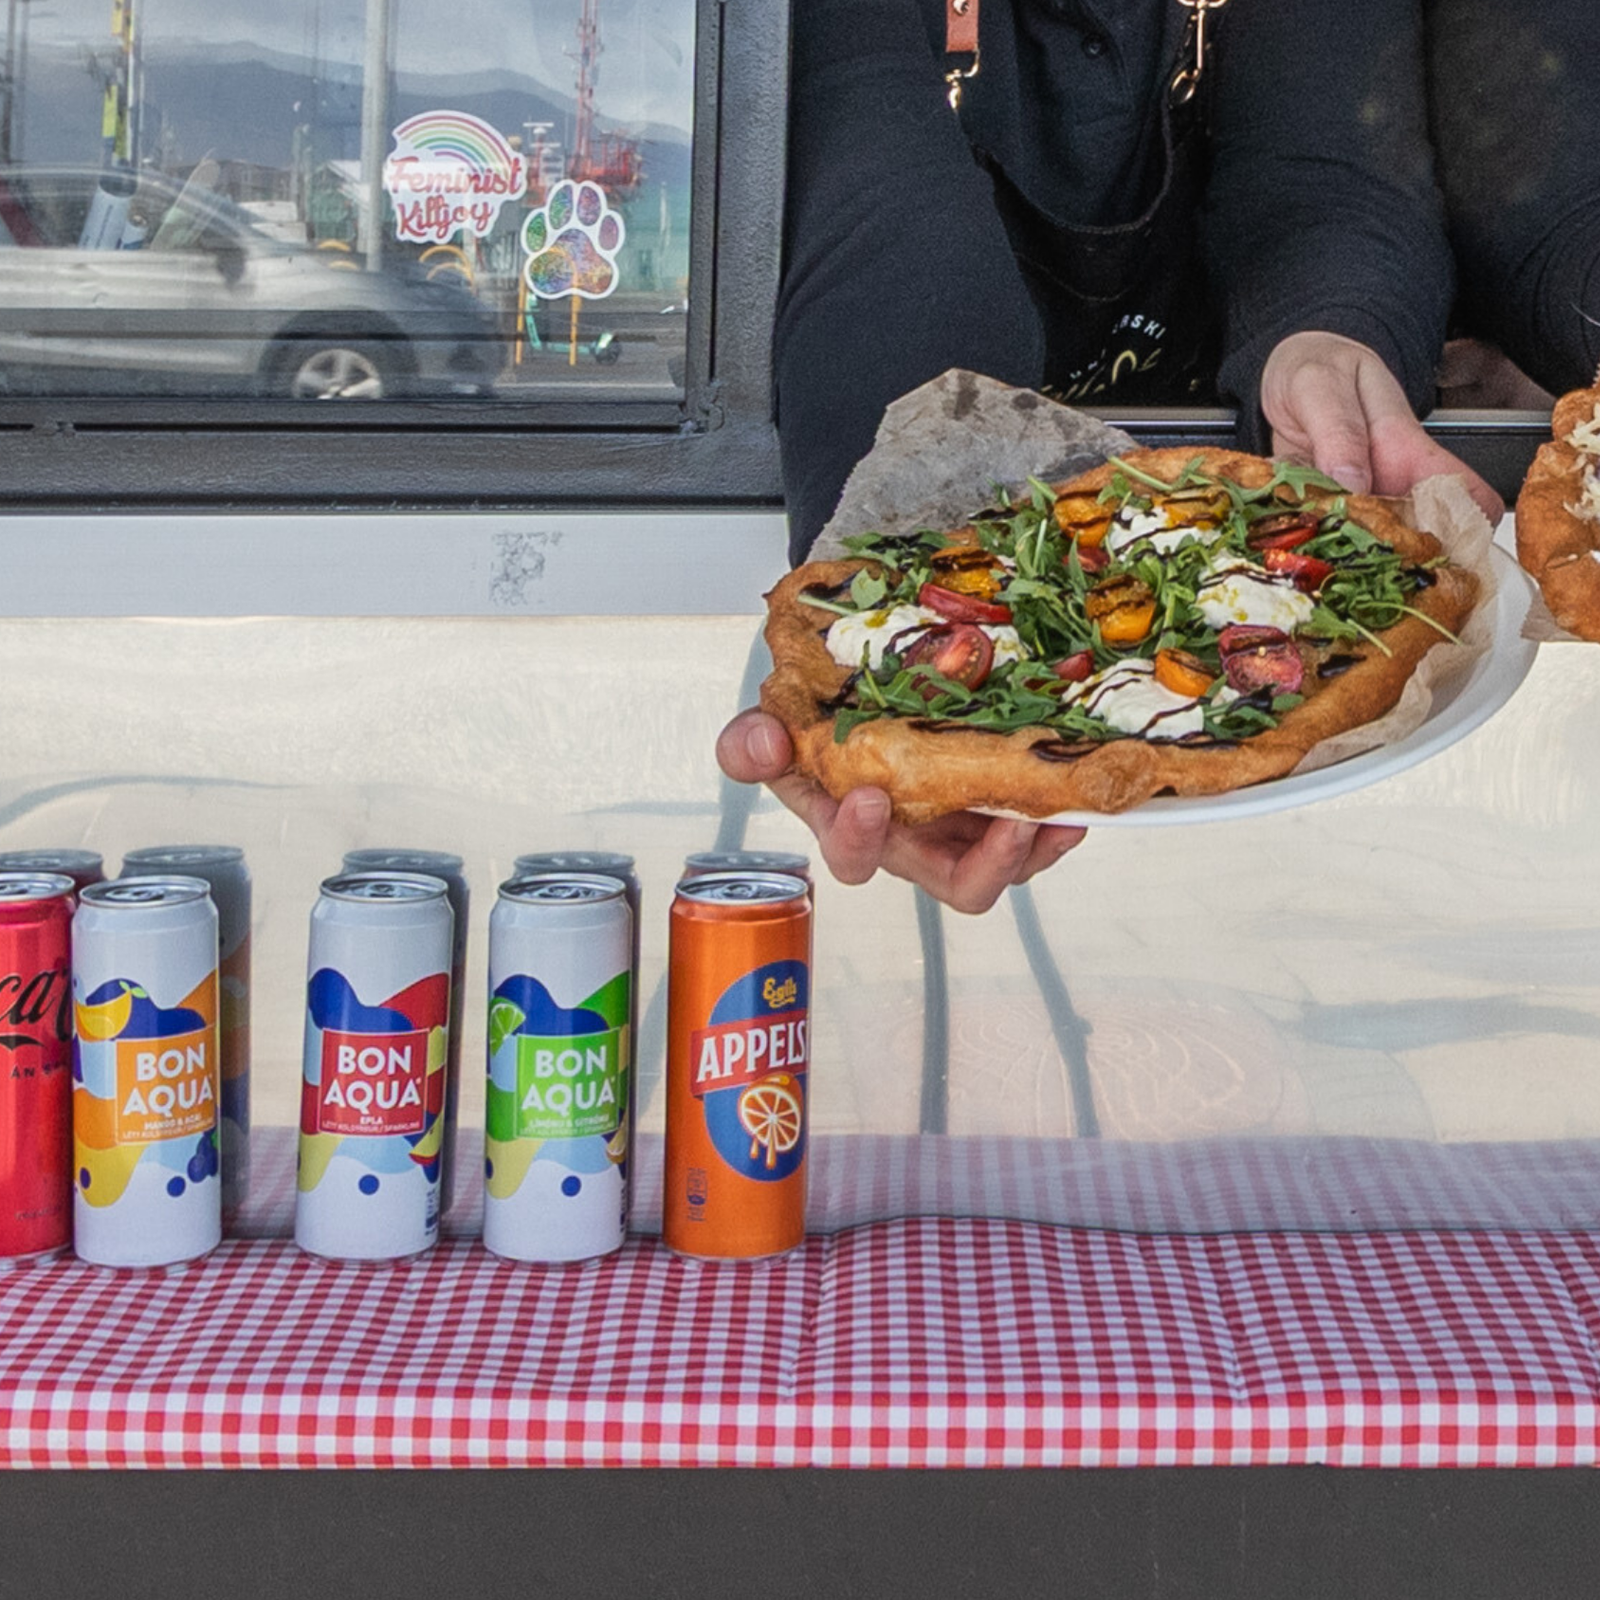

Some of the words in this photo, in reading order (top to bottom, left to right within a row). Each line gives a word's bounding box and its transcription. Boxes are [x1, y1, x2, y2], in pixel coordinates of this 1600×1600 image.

[388, 156, 521, 194] Feminist
[398, 195, 492, 237] Killjoy
[136, 1041, 205, 1082] BON
[338, 1044, 412, 1076] BON
[535, 1045, 607, 1078] BON
[122, 1075, 214, 1117] AQUA
[323, 1078, 421, 1115] AQUA
[522, 1078, 615, 1118] AQUA
